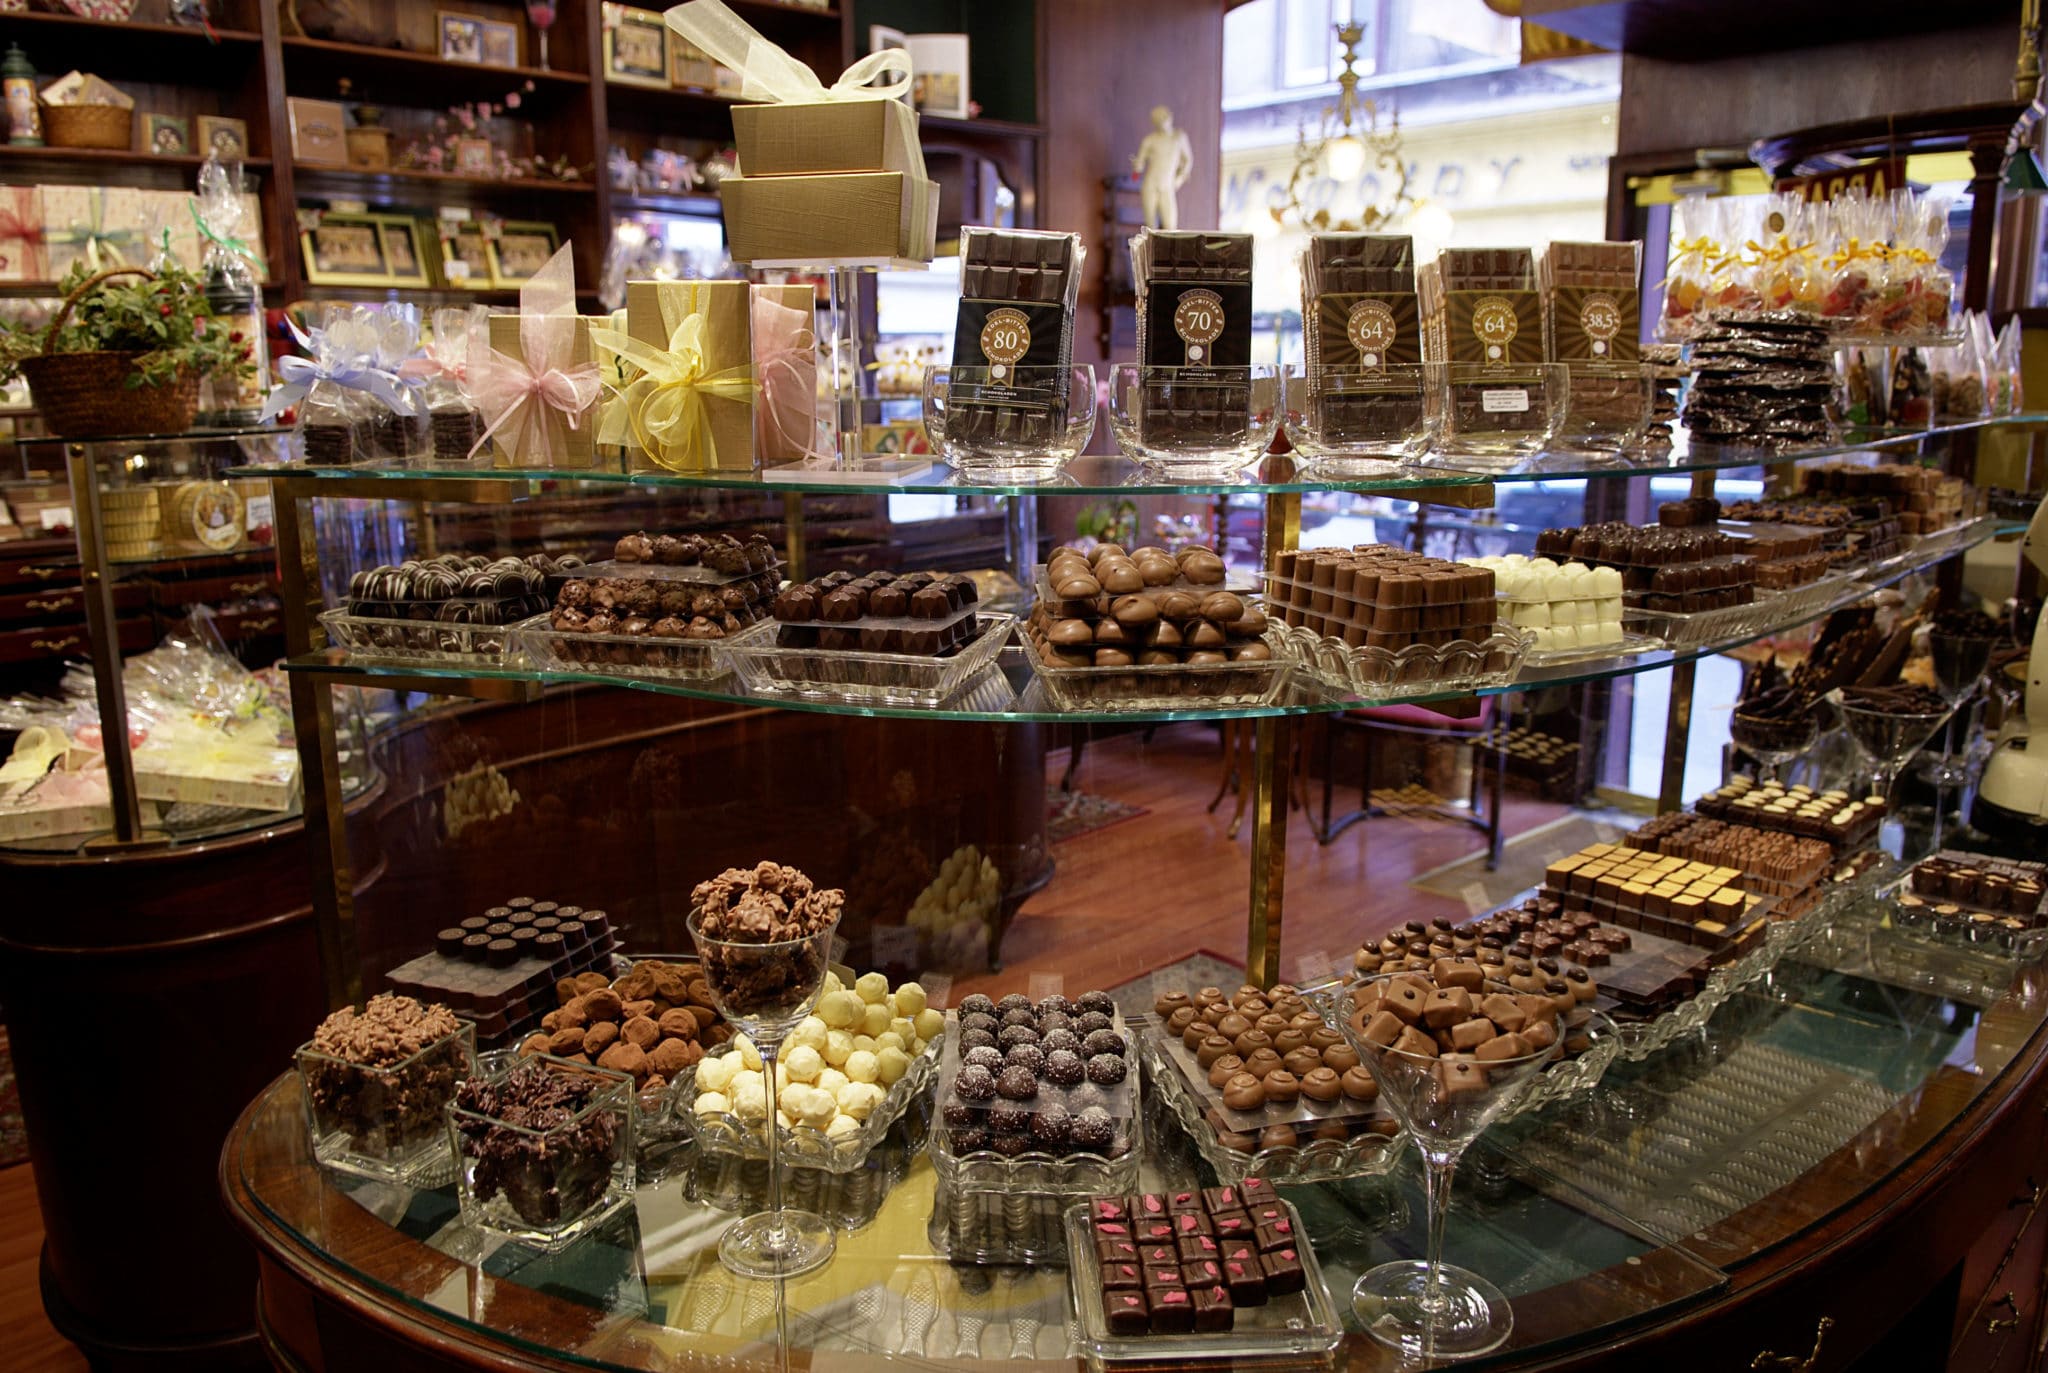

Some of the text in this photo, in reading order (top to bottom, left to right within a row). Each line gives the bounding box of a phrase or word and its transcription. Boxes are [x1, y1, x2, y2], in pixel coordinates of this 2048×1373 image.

[1180, 298, 1219, 314] EDEL-BITTER
[987, 318, 1026, 334] EDEL-BITTER
[1188, 311, 1211, 331] 70
[1484, 315, 1506, 333] 64
[1588, 313, 1614, 329] 38,5
[1180, 328, 1218, 343] SCHOKOLADE
[1360, 321, 1383, 340] 64
[993, 330, 1018, 350] 80
[1353, 335, 1392, 352] SCHOKOLADE
[985, 346, 1024, 362] SCHOKOLADE
